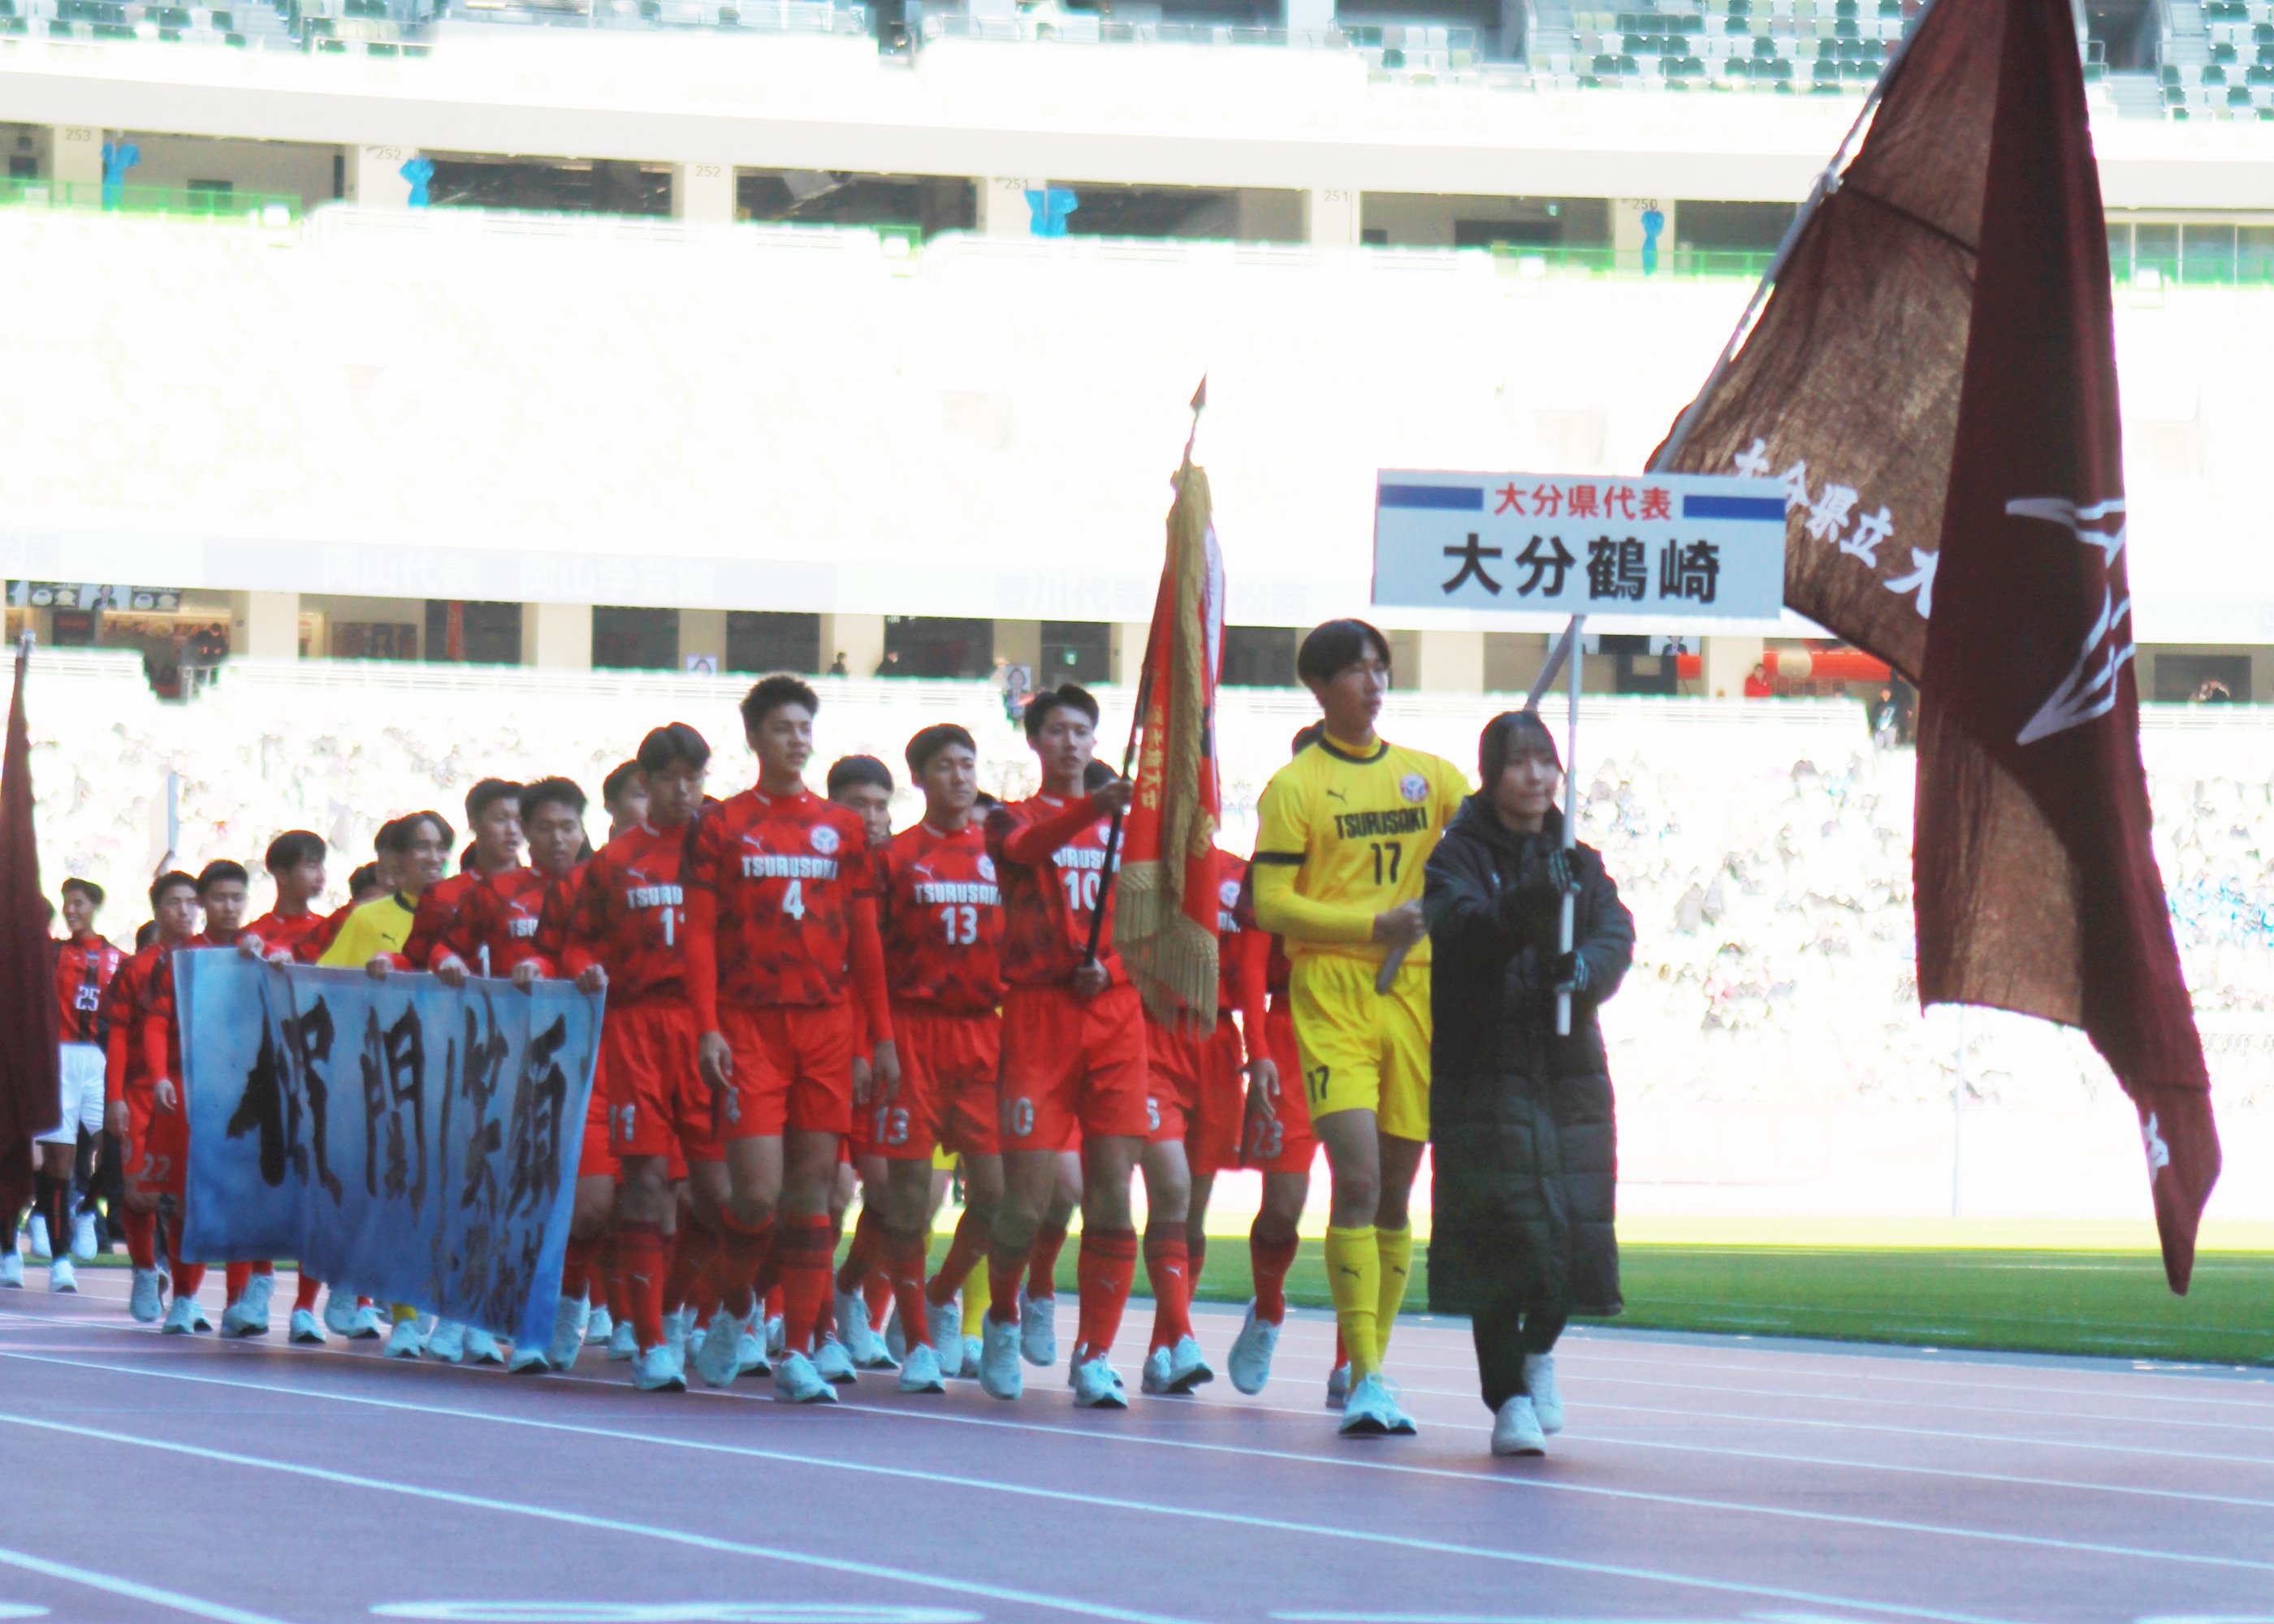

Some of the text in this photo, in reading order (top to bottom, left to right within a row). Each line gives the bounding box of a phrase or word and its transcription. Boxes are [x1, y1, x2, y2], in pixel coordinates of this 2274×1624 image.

[66, 127, 92, 142] 253
[377, 148, 402, 161] 252
[695, 165, 721, 178] 252
[1004, 178, 1029, 190] 251
[1323, 190, 1349, 202] 251
[1632, 197, 1658, 209] 250
[1494, 482, 1672, 521] 大分県代表
[1441, 532, 1722, 604] 大分鶴崎
[1334, 806, 1428, 840] TSURUSAKI
[741, 855, 838, 881] TSURUSAKI
[1370, 841, 1402, 887] 17
[782, 878, 806, 921] 4
[1063, 870, 1101, 911] 10
[659, 906, 685, 947] 1
[940, 905, 978, 945] 13
[76, 985, 101, 1012] 25
[1308, 1065, 1329, 1104] 17
[875, 1107, 910, 1146] 13
[1002, 1097, 1035, 1138] 10
[138, 1152, 171, 1183] 22
